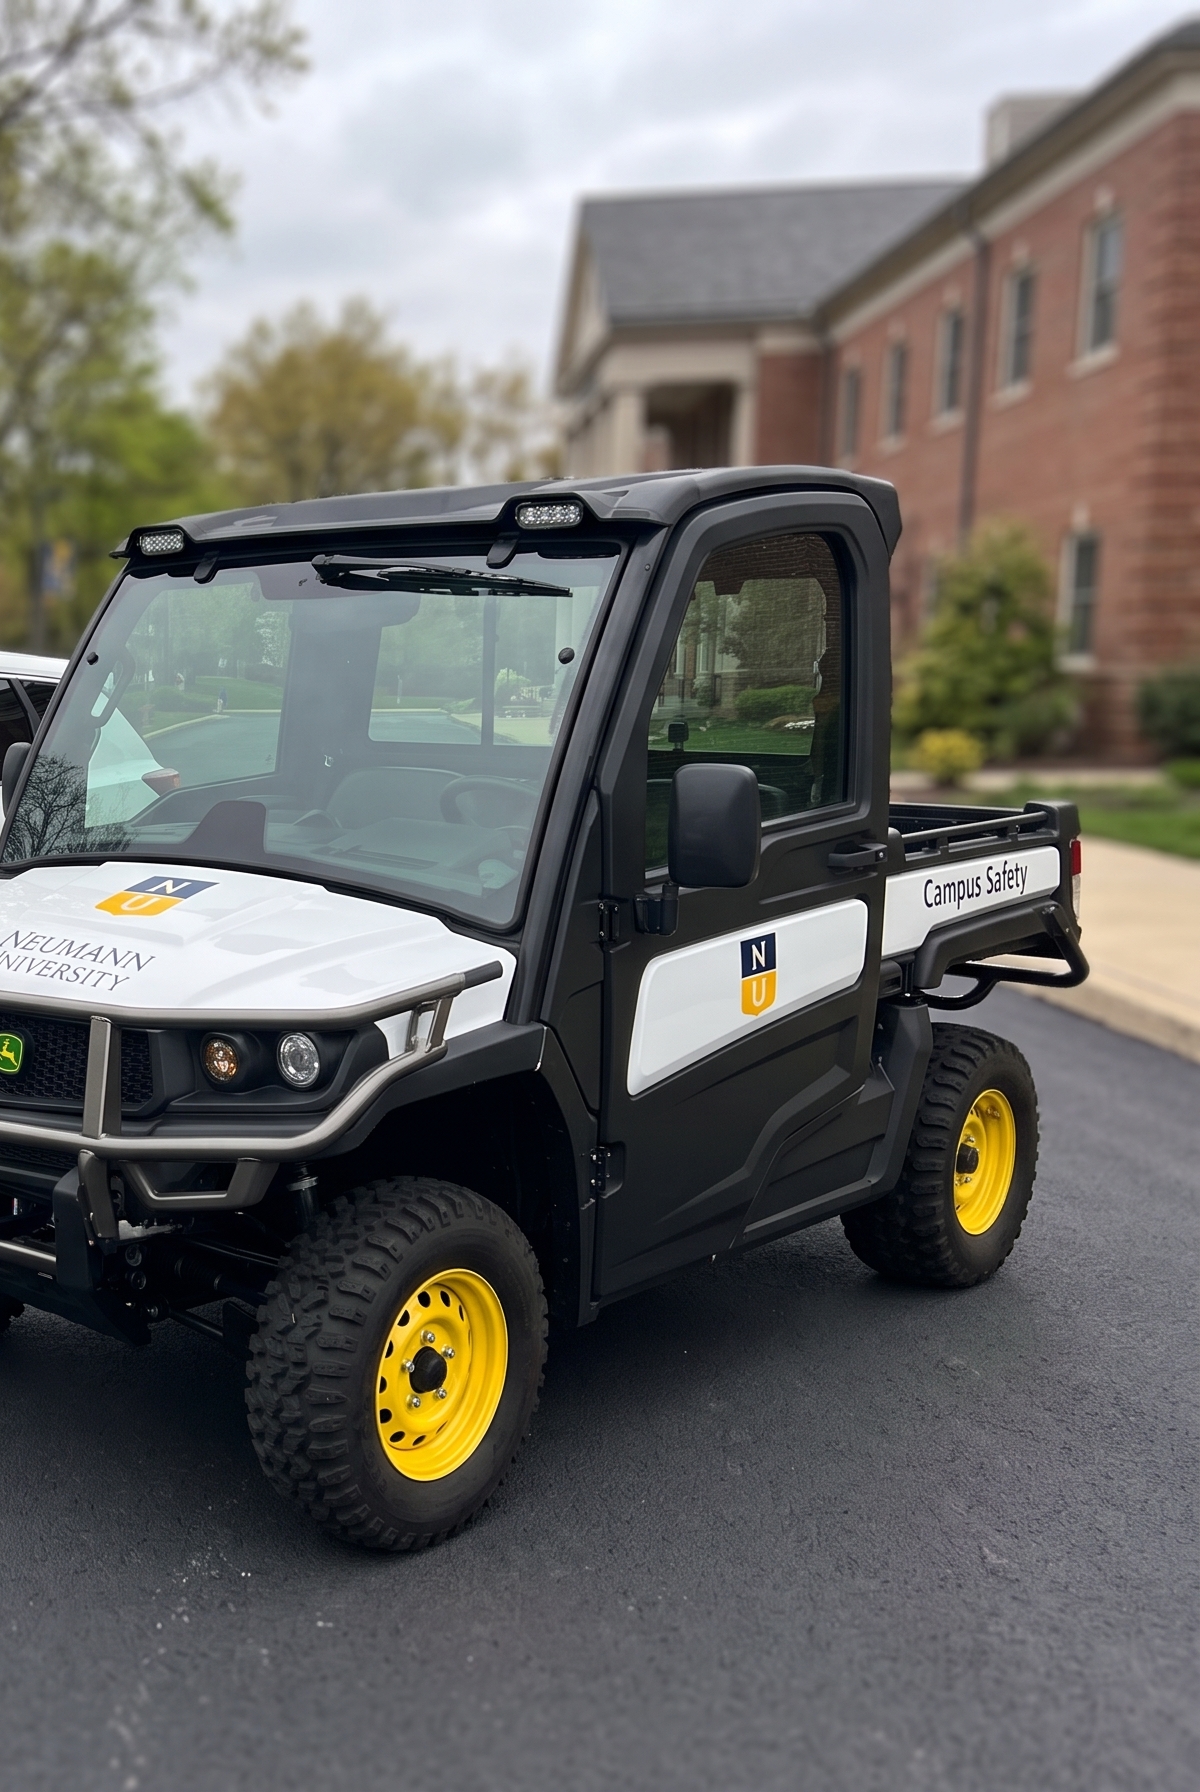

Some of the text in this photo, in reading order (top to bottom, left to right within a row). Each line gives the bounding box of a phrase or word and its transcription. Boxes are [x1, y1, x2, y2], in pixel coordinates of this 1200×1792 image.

[145, 879, 193, 896] N
[923, 860, 1028, 910] Campus Safety
[121, 895, 155, 911] U
[751, 940, 766, 971] N
[751, 977, 767, 1007] U
